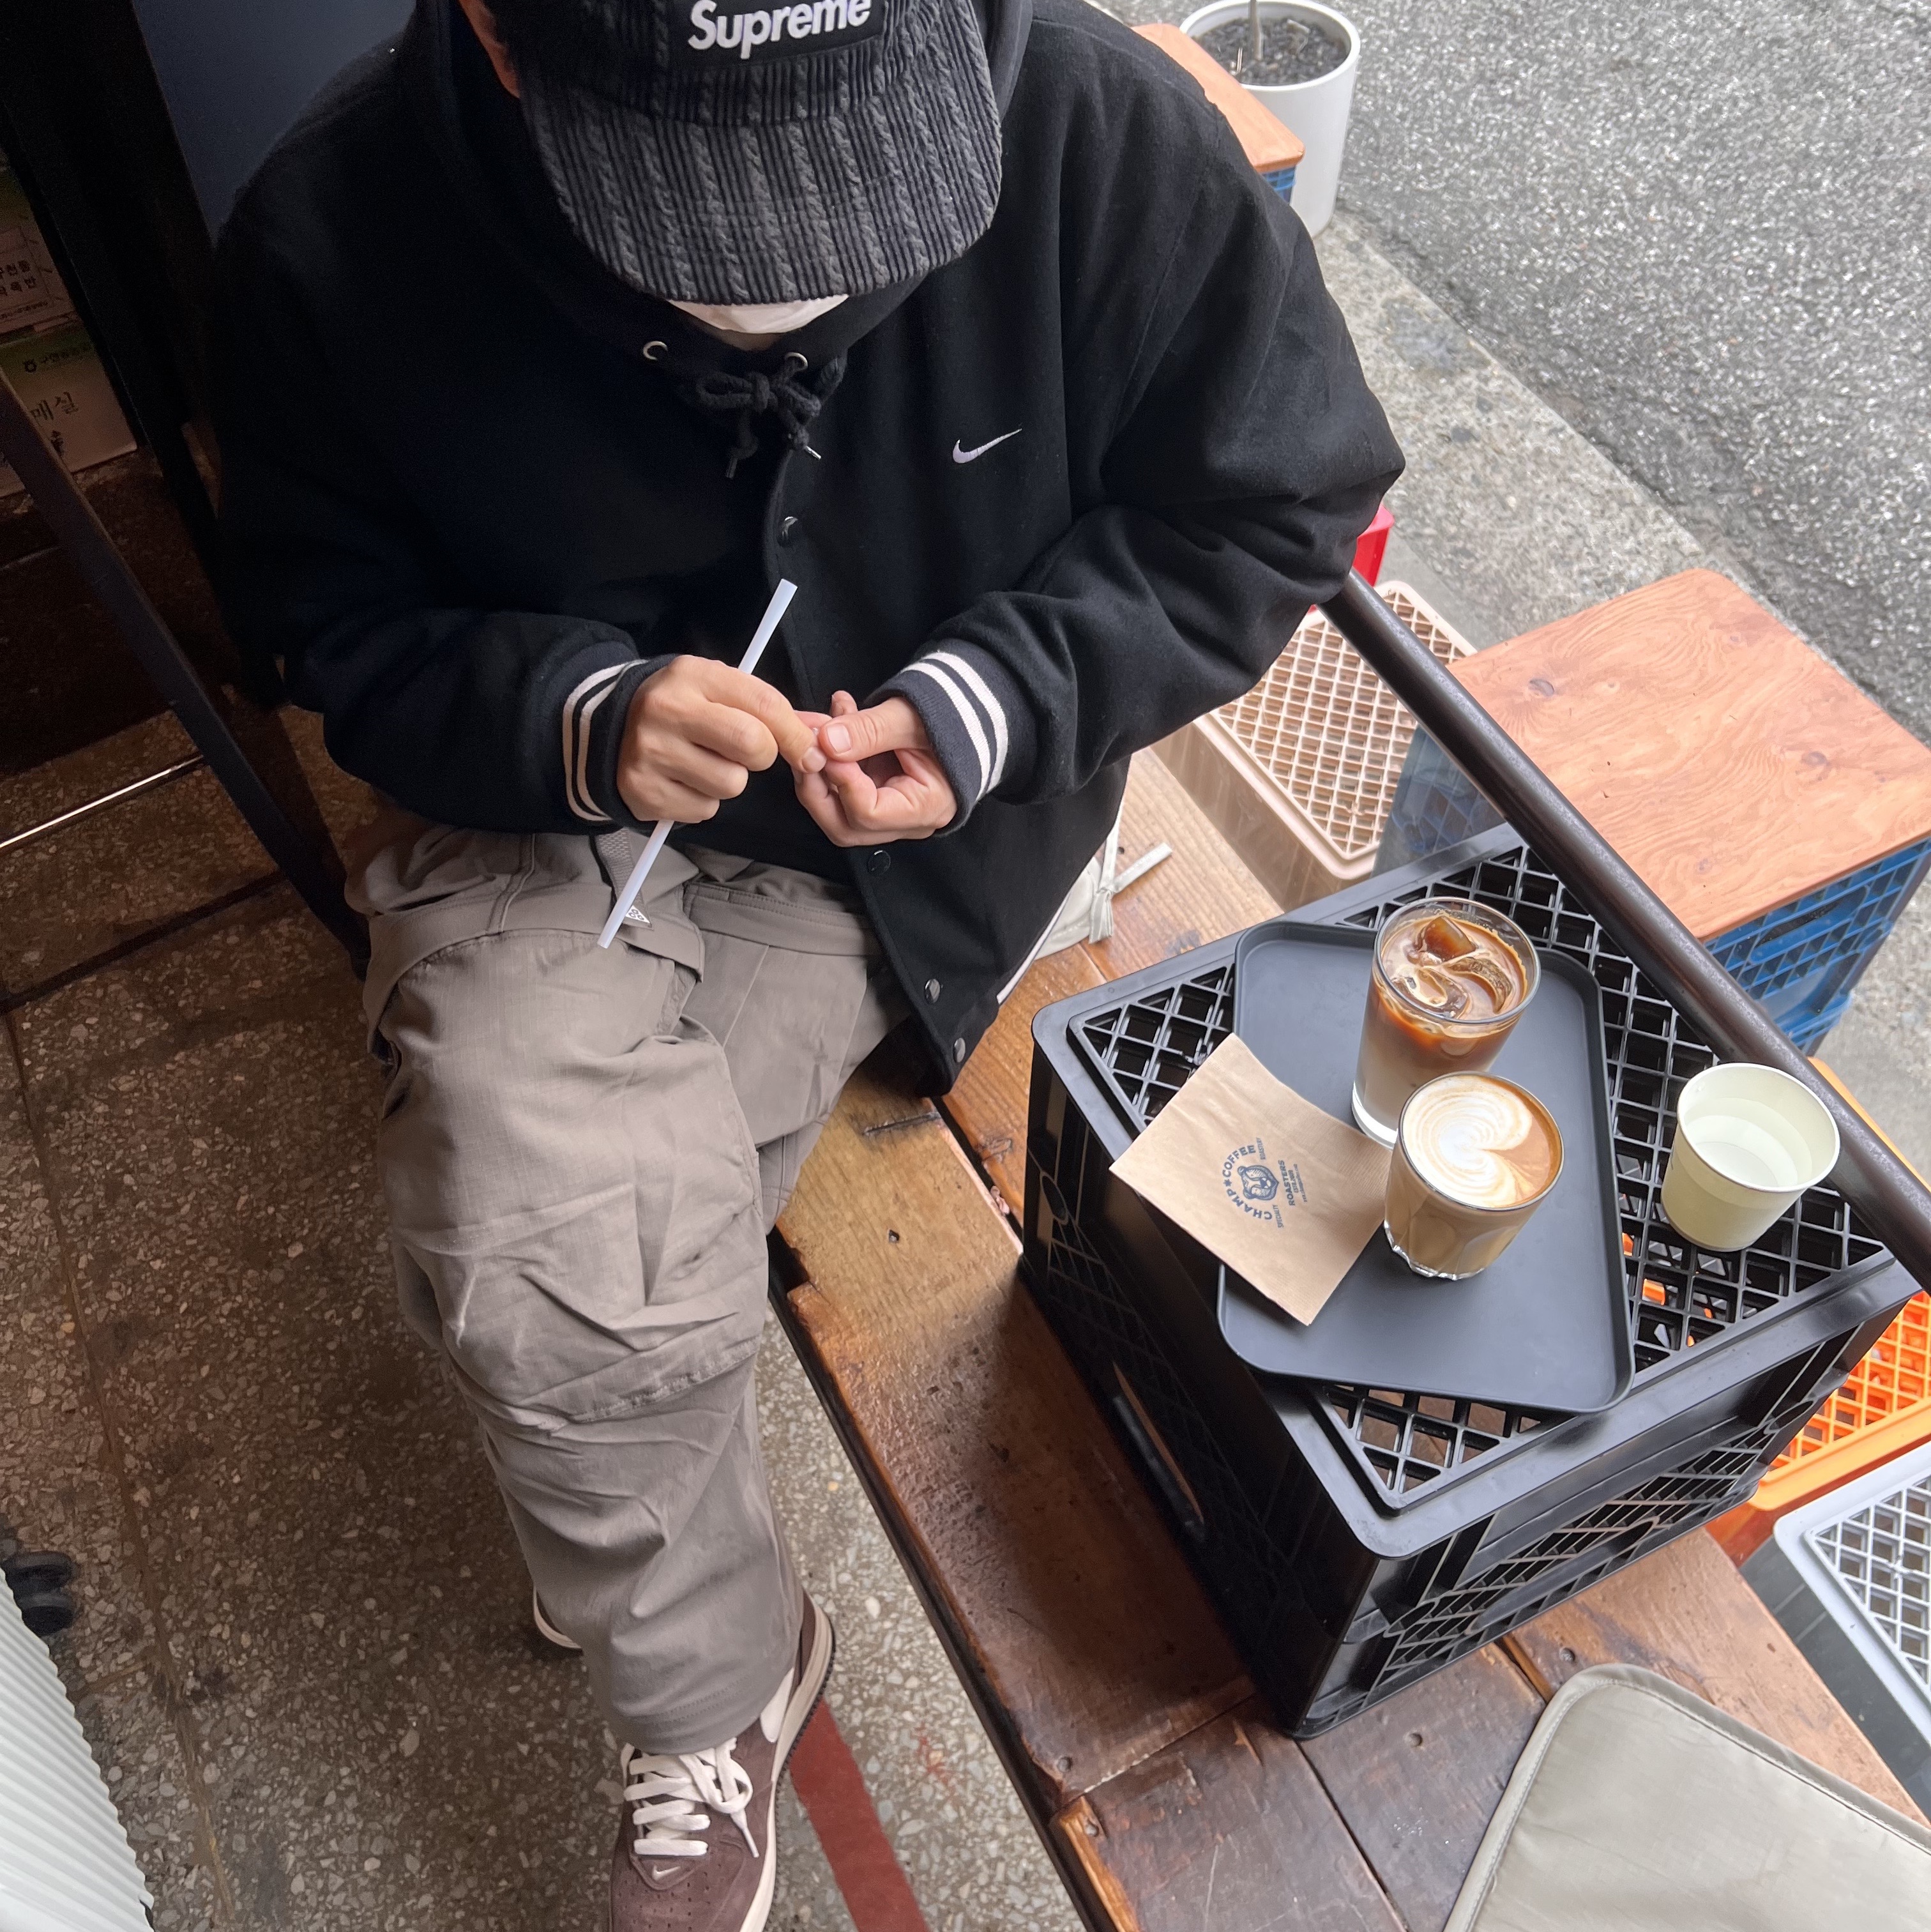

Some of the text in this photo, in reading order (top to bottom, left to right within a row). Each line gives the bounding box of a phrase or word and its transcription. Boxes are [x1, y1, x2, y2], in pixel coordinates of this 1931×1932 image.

[688, 0, 871, 59] Supreme
[1222, 1145, 1273, 1219] CHAMP COFFEE
[1278, 1160, 1295, 1206] ROASTERS
